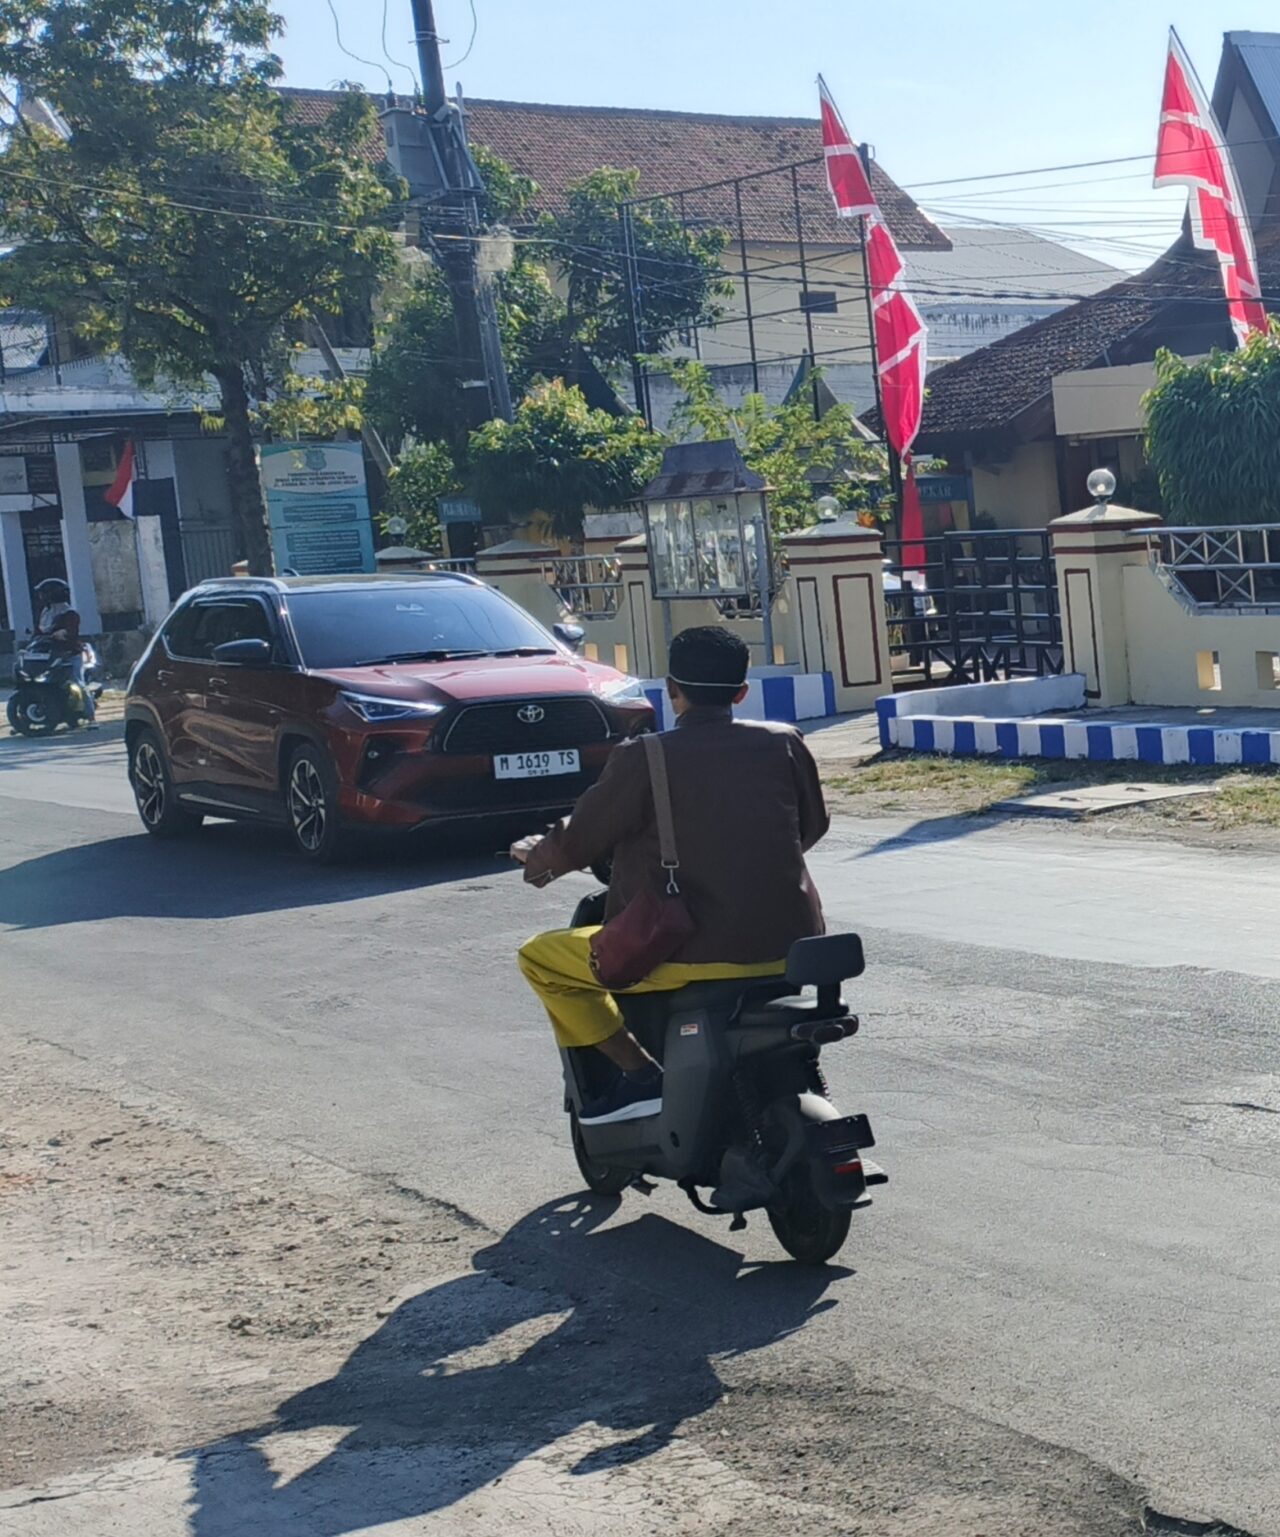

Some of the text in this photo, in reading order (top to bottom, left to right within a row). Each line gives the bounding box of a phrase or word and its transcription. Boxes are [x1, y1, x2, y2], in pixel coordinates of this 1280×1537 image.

[500, 752, 575, 771] M 1619 TS
